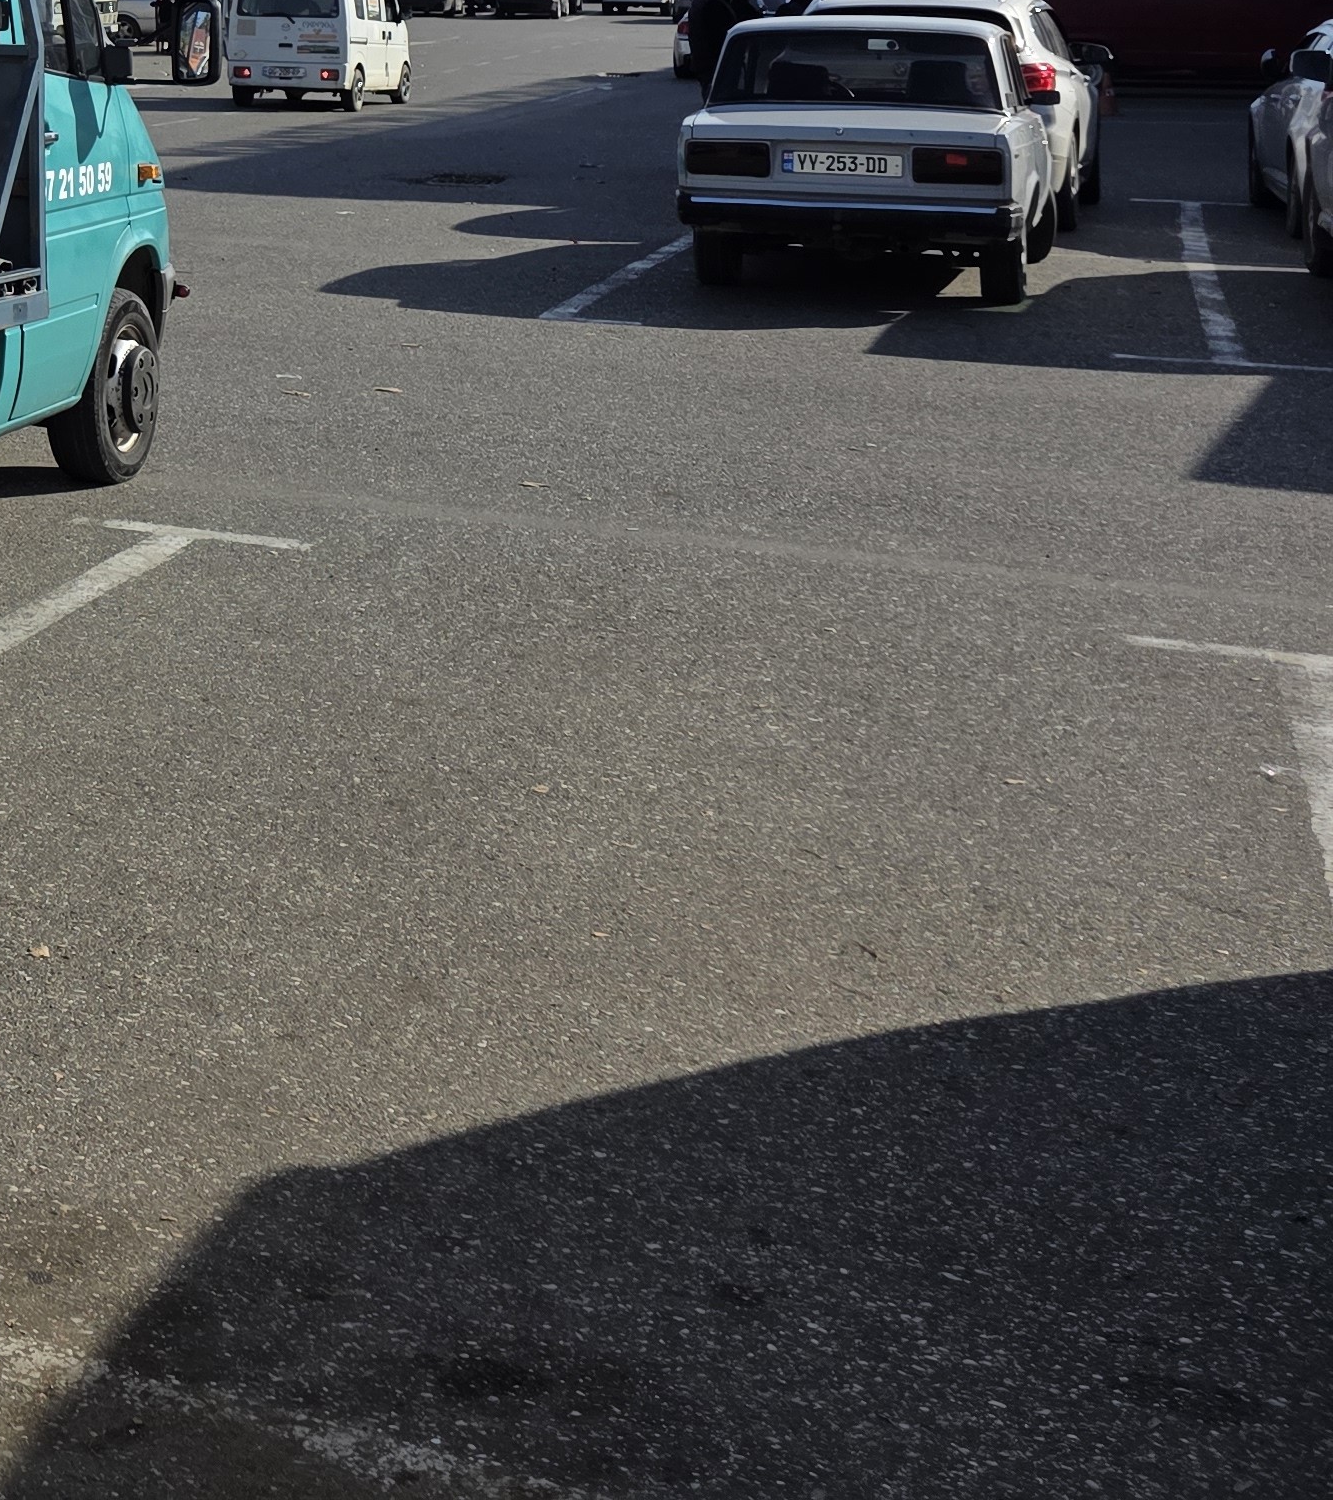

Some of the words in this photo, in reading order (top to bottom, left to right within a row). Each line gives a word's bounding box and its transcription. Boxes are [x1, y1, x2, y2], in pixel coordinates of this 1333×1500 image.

[798, 154, 887, 174] YY-253-DD
[58, 167, 74, 199] 21
[78, 164, 94, 197] 50
[97, 161, 112, 193] 59
